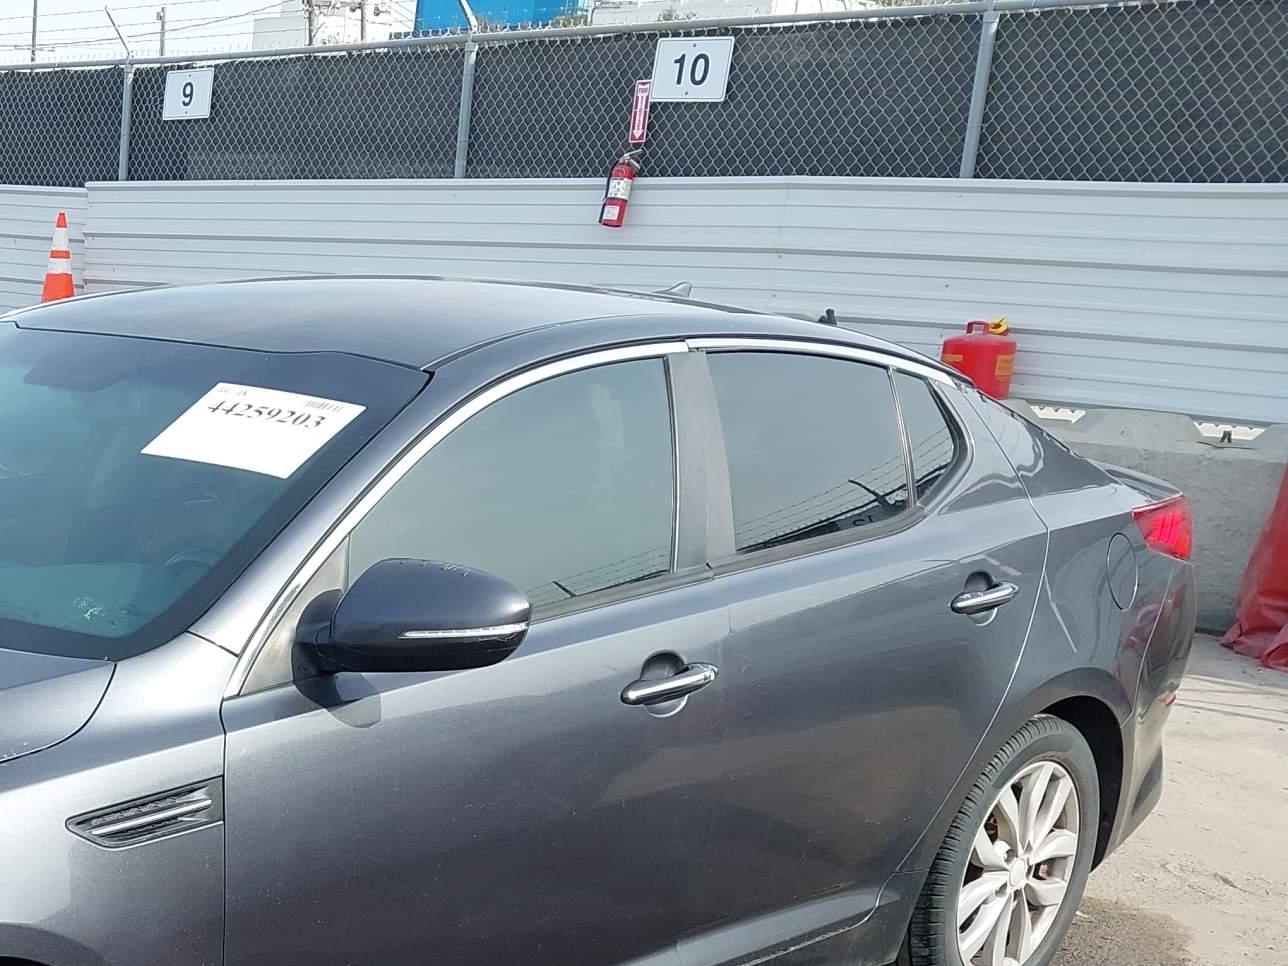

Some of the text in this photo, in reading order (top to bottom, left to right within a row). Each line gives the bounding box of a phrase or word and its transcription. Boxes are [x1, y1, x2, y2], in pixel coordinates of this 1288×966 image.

[673, 53, 710, 86] 10
[182, 81, 194, 107] 9
[208, 400, 326, 429] 44259203
